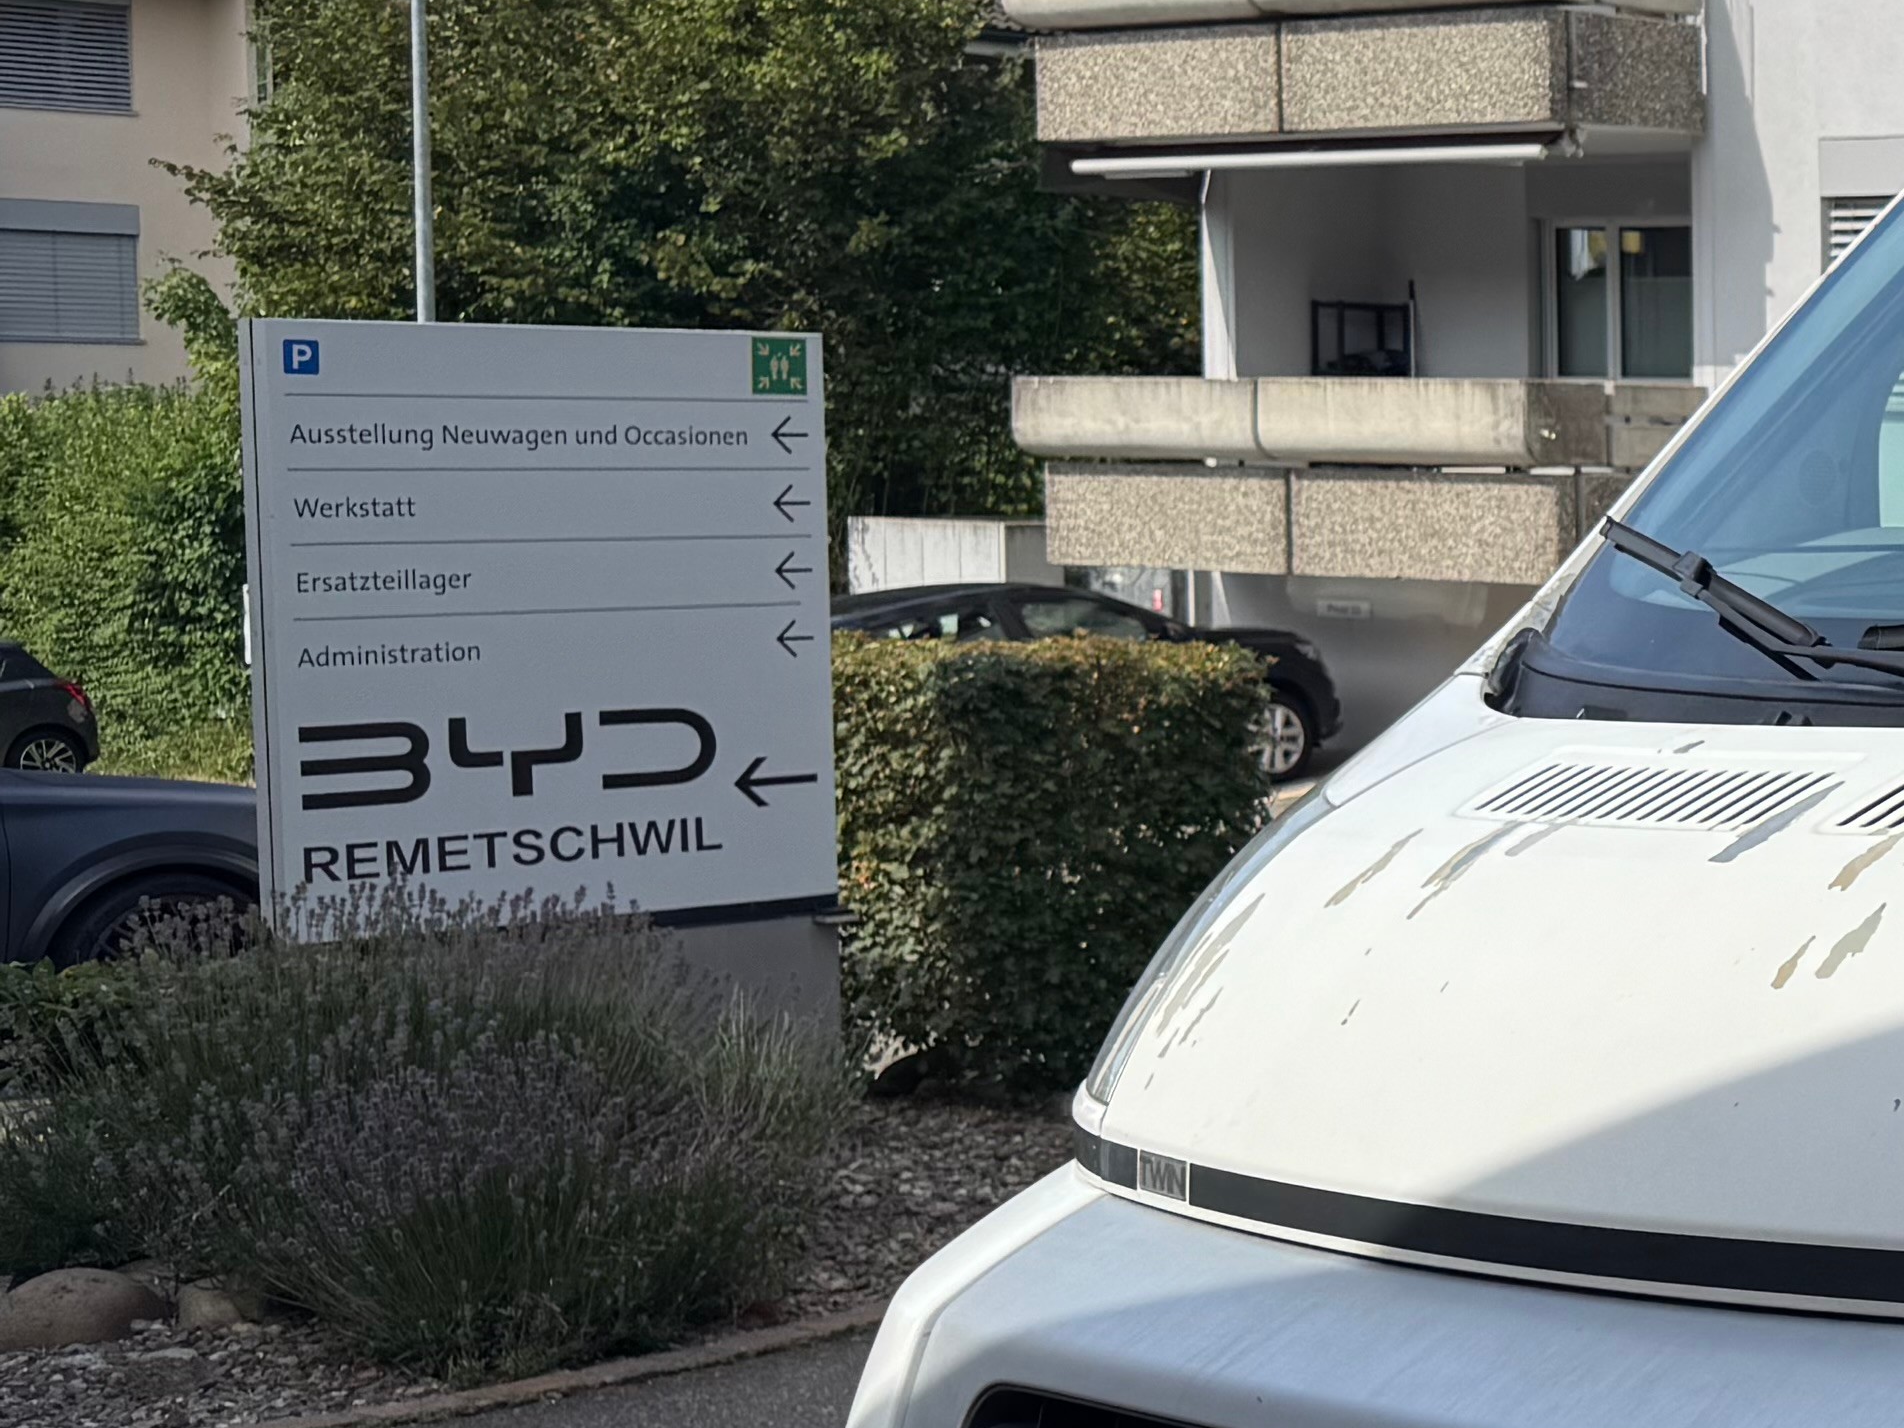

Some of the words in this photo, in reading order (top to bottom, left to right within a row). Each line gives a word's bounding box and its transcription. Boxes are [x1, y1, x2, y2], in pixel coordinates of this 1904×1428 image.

[291, 344, 312, 370] P
[290, 422, 433, 451] Ausstellung
[443, 424, 567, 451] Neuwagen
[576, 424, 617, 445] und
[624, 425, 748, 446] Occasionen
[293, 495, 416, 519] Werkstatt
[296, 569, 472, 595] Ersatzteillager
[298, 640, 481, 669] Administration
[298, 708, 717, 811] BYD
[303, 817, 723, 884] REMETSCHWIL
